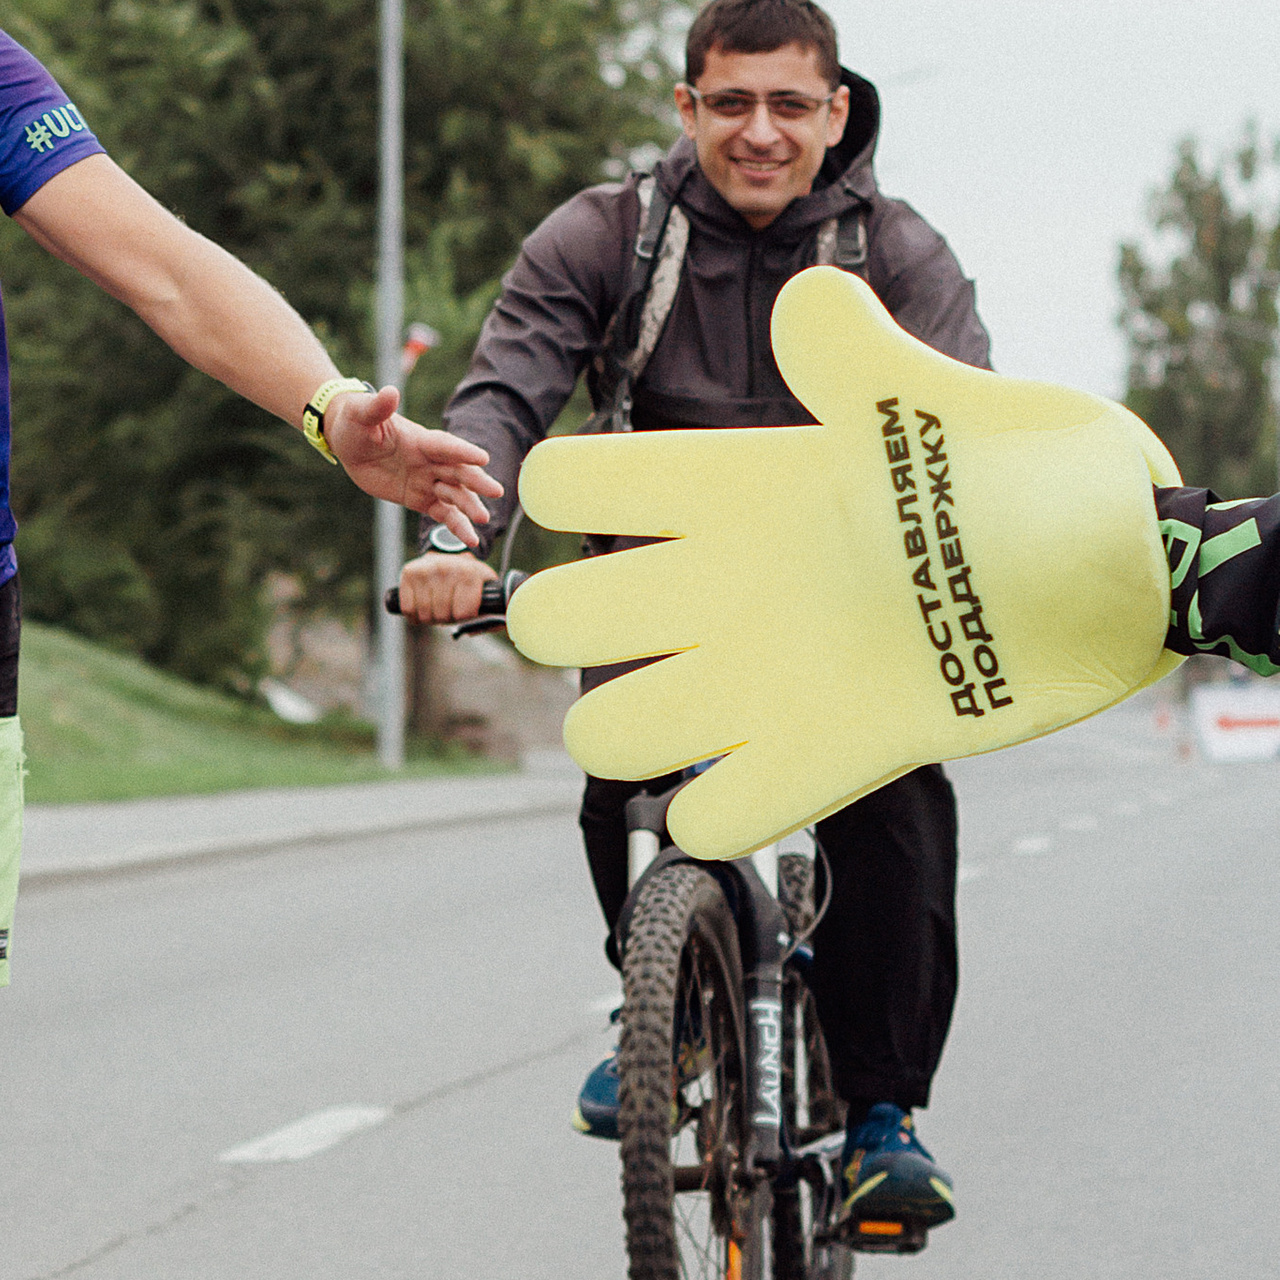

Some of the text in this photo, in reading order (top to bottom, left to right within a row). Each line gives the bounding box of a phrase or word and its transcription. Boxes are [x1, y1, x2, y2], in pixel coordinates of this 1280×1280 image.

[875, 396, 985, 718] ДОСТАВЛЯЕМ
[914, 408, 1014, 710] ПОДДЕРЖКУ
[750, 1000, 783, 1129] LAUNCH
